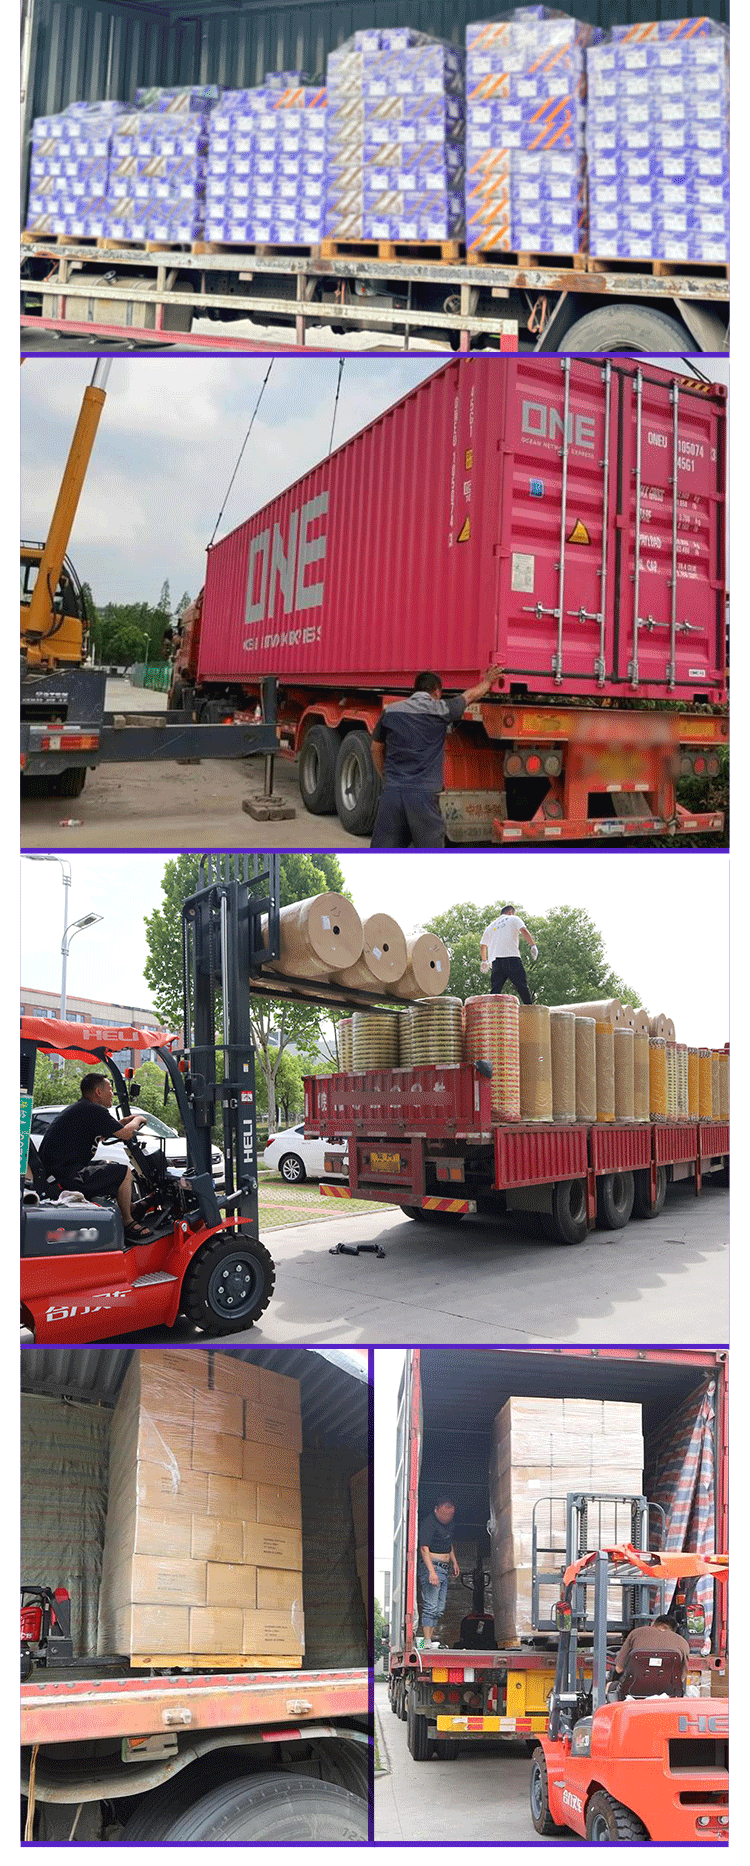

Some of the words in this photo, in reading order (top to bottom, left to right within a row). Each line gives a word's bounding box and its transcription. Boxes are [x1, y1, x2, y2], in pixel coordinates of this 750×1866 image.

[522, 400, 595, 450] ONE
[244, 490, 330, 625] ONE
[83, 1029, 140, 1042] HELI
[243, 1119, 254, 1164] HELI
